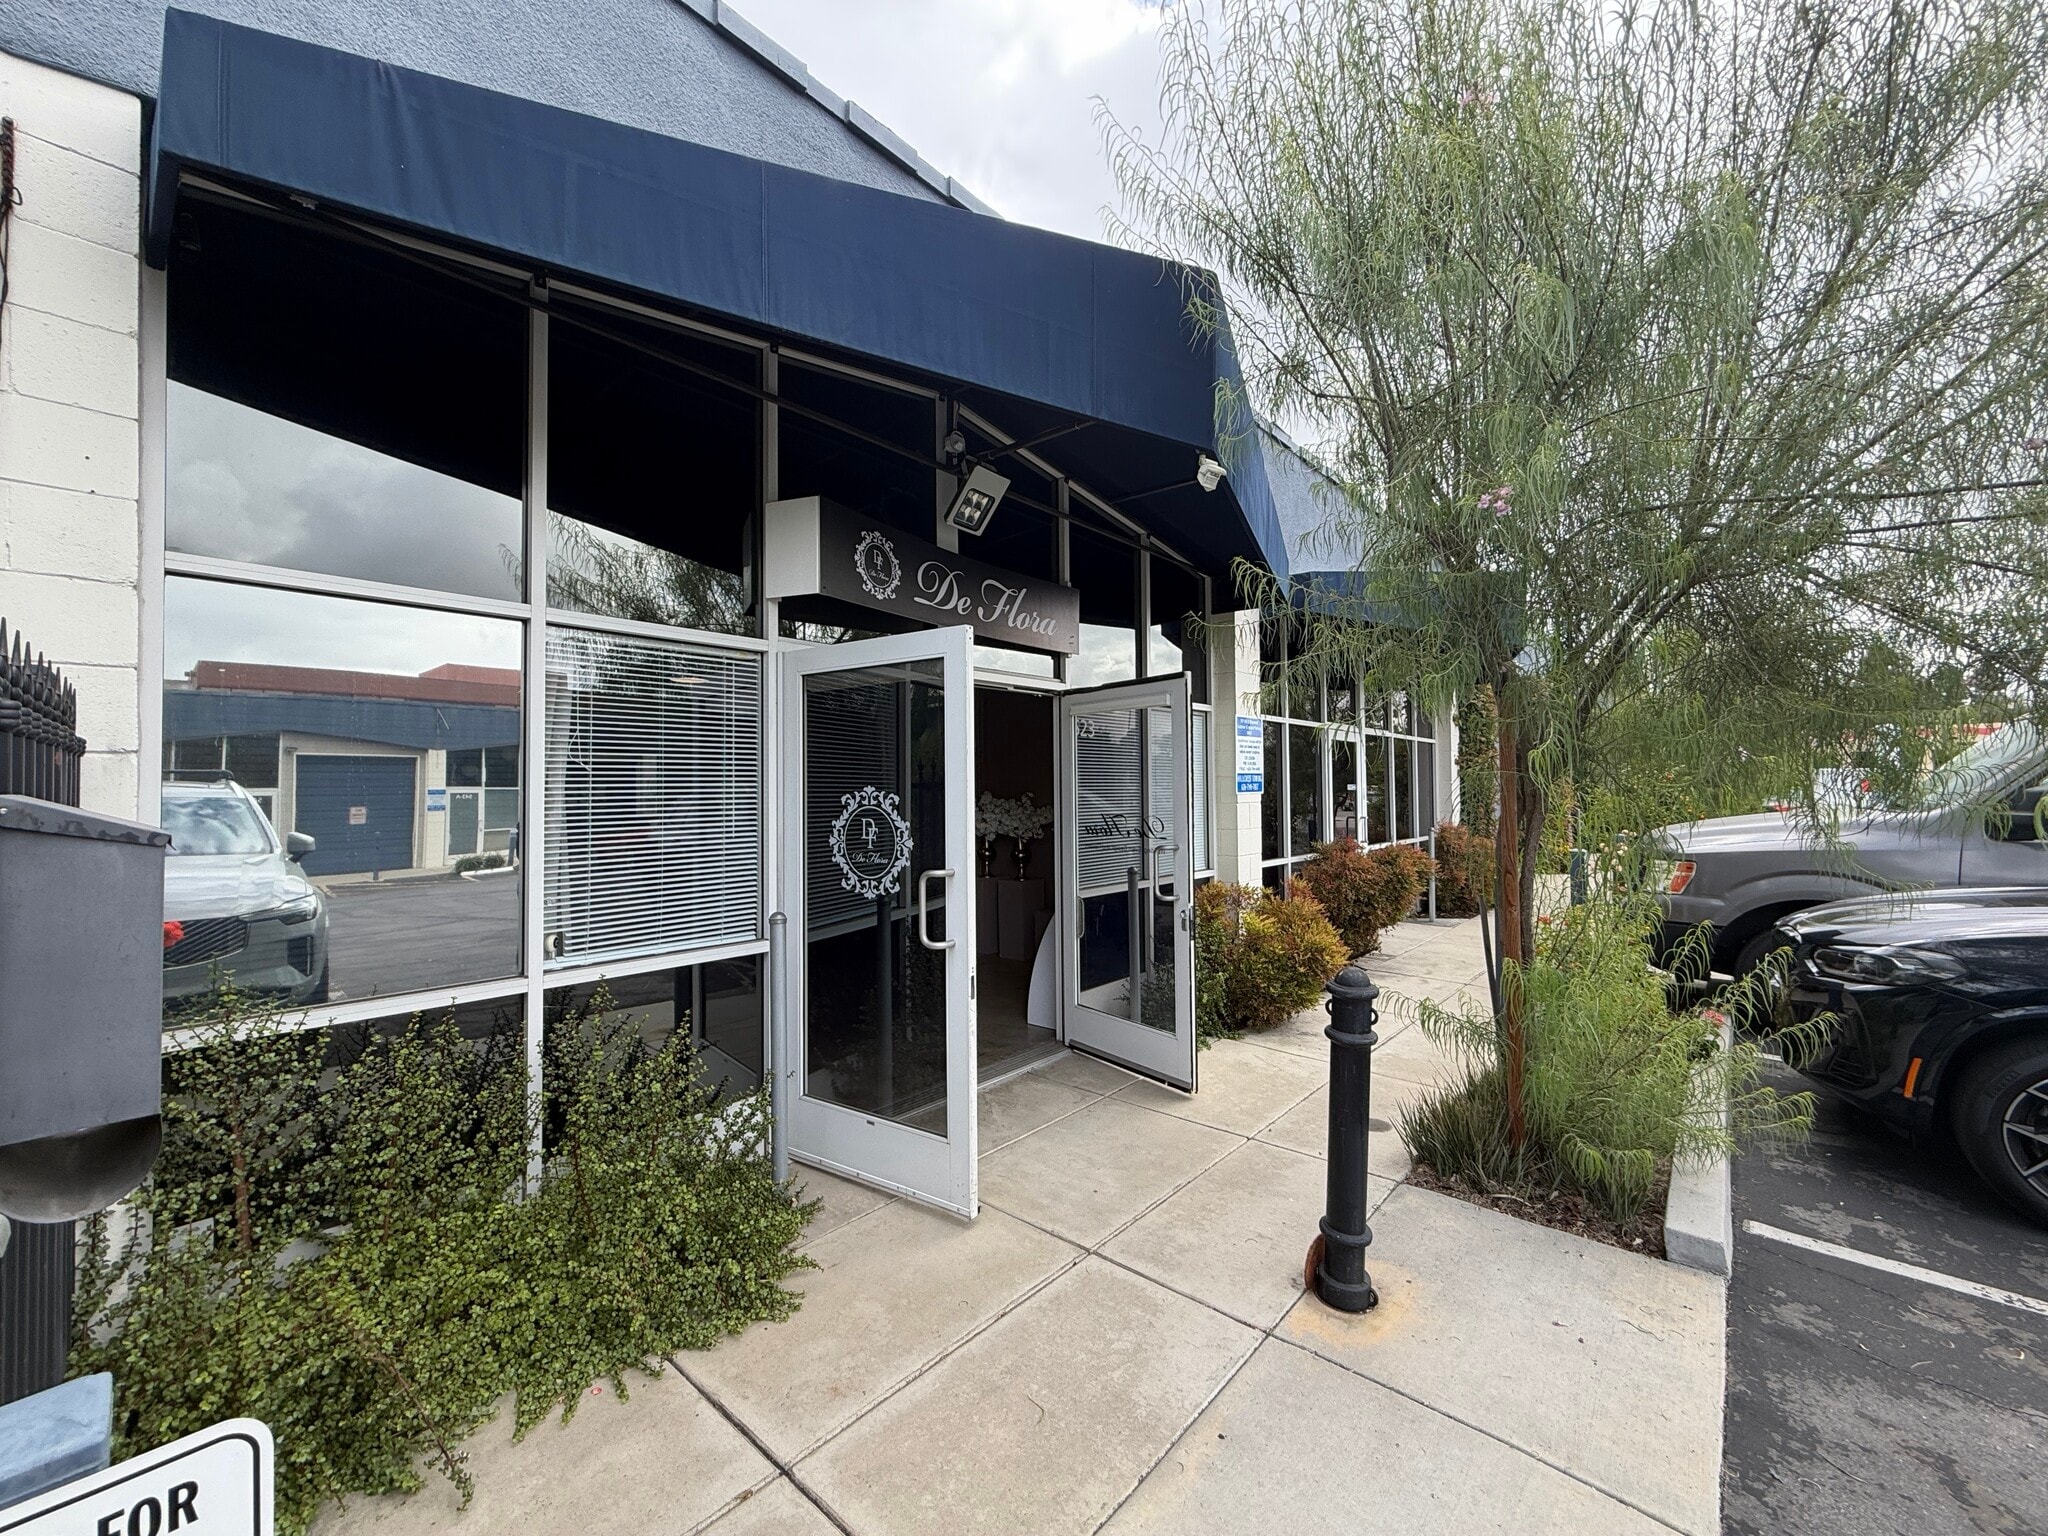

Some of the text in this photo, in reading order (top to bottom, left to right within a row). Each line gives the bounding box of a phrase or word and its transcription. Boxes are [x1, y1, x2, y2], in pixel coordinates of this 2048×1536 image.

[913, 560, 1058, 637] De Flora
[852, 851, 889, 863] De Flora
[97, 1480, 199, 1536] FOR
